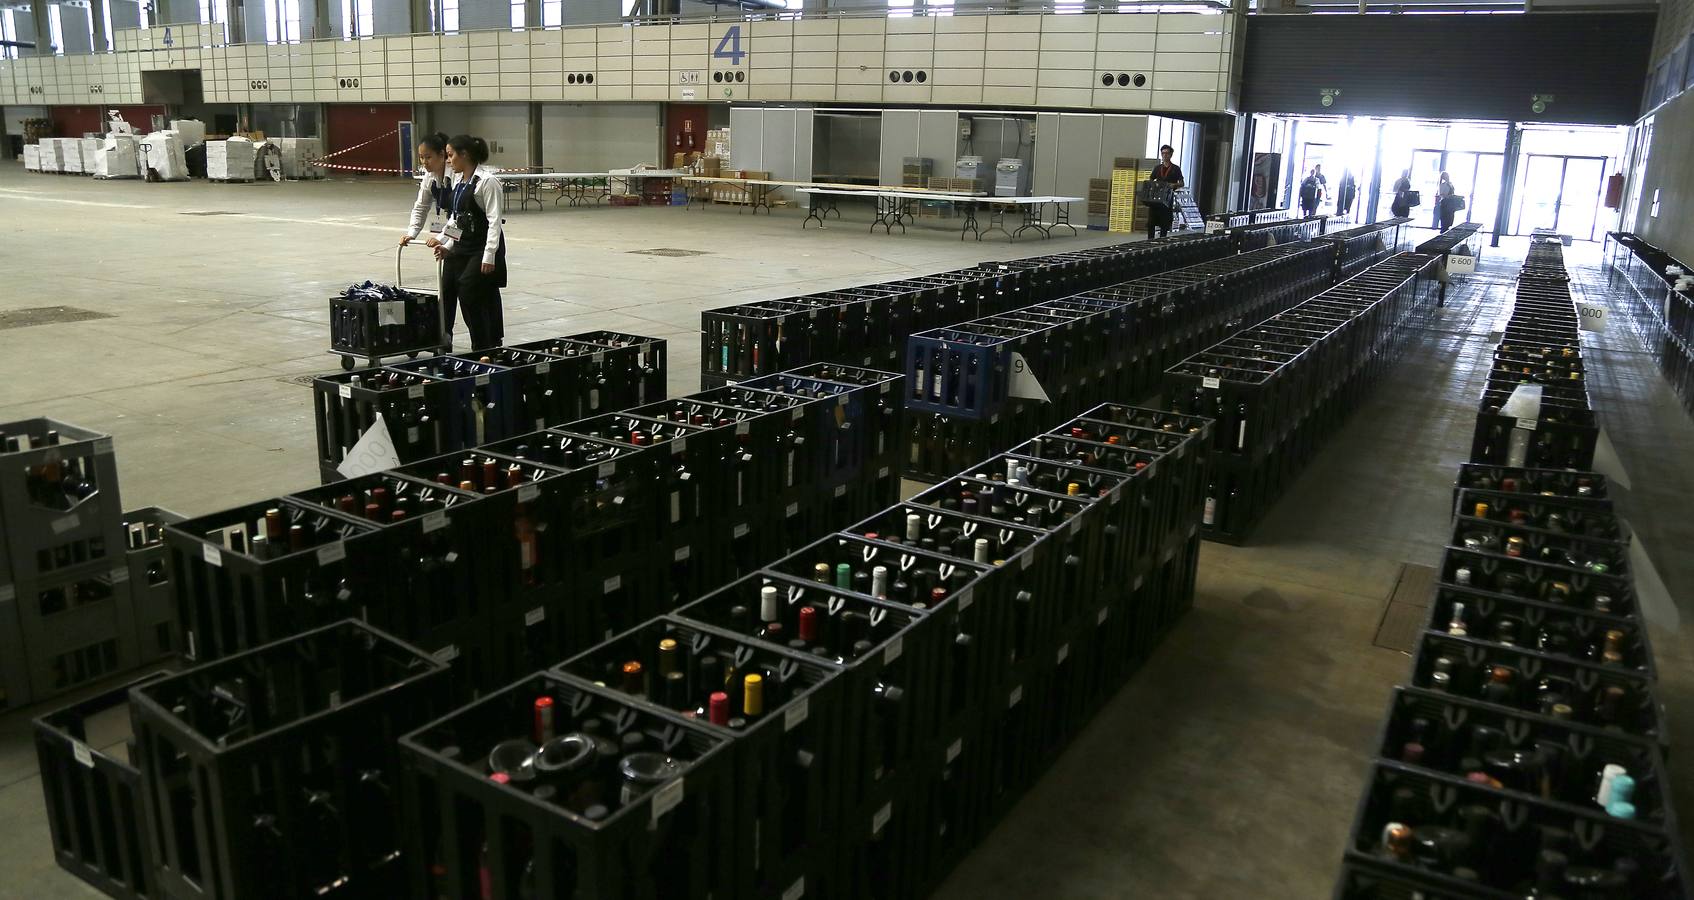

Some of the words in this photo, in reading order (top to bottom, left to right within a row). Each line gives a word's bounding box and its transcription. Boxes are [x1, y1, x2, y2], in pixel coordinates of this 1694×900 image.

[163, 27, 173, 47] 4
[714, 26, 745, 65] 4
[1457, 258, 1472, 266] 600
[1581, 307, 1602, 319] 000
[1015, 359, 1024, 374] 9
